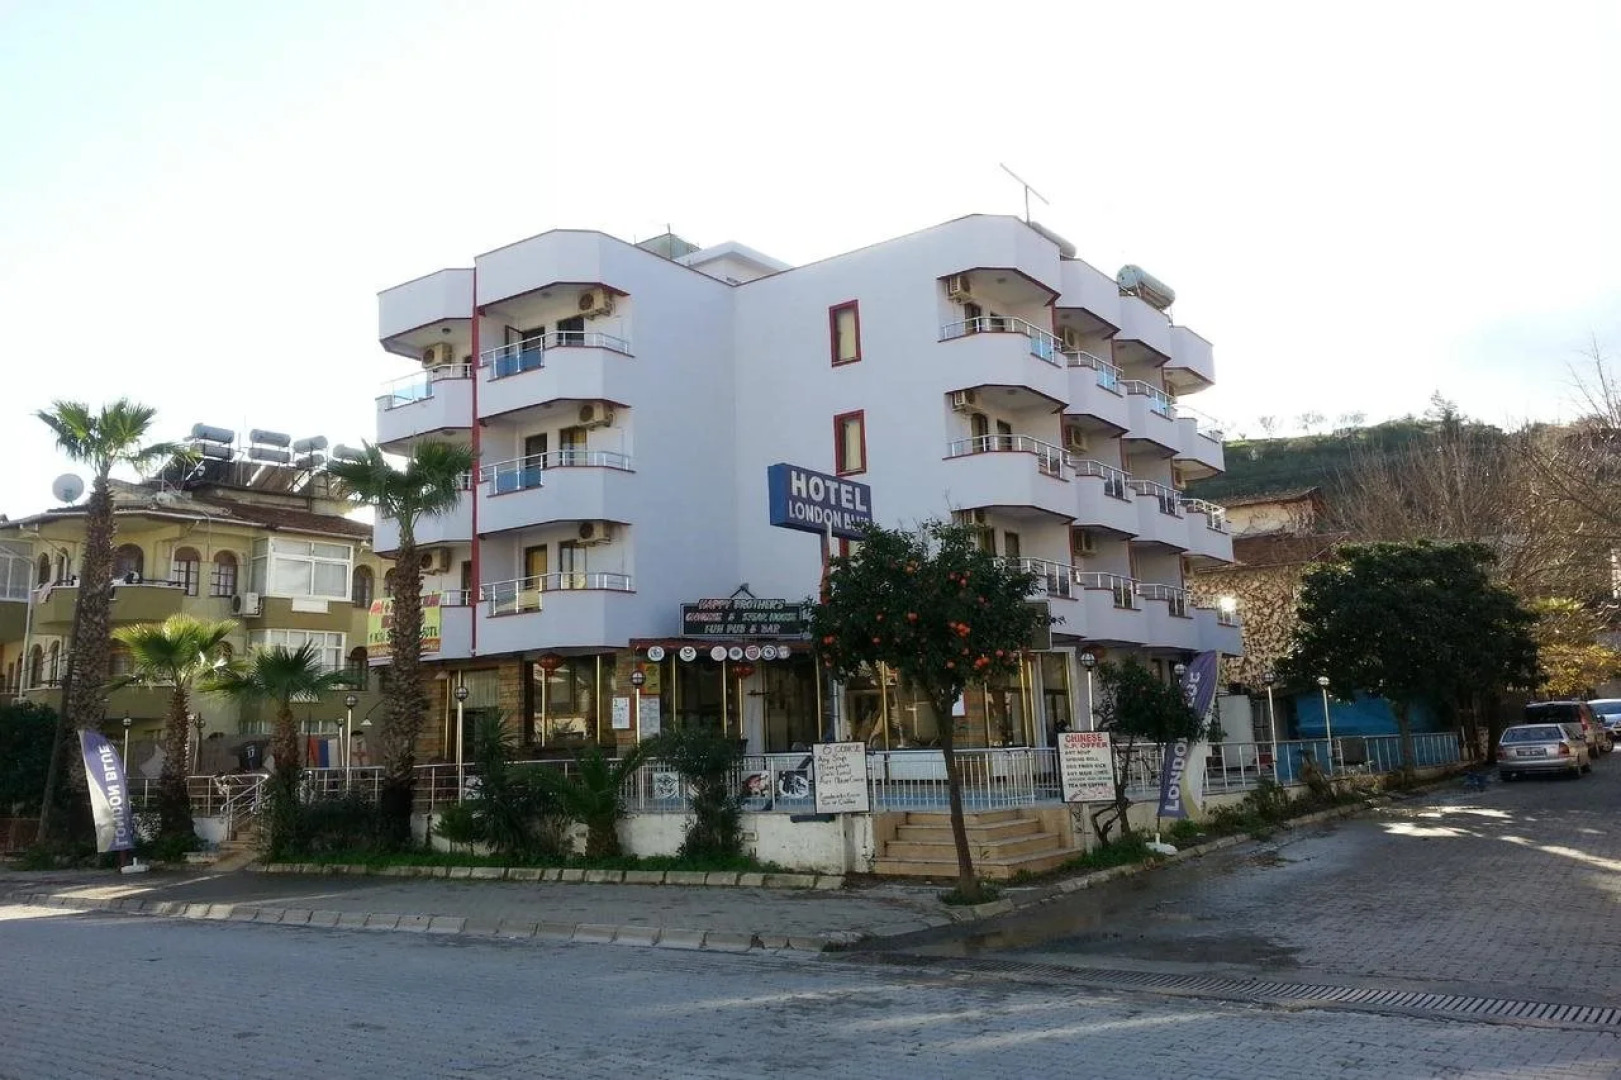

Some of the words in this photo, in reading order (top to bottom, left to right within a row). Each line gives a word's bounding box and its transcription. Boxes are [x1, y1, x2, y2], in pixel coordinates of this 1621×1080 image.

[790, 470, 867, 513] HOTEL
[788, 499, 842, 529] LONDON
[843, 512, 870, 531] BLU
[1064, 733, 1103, 743] CHINESE
